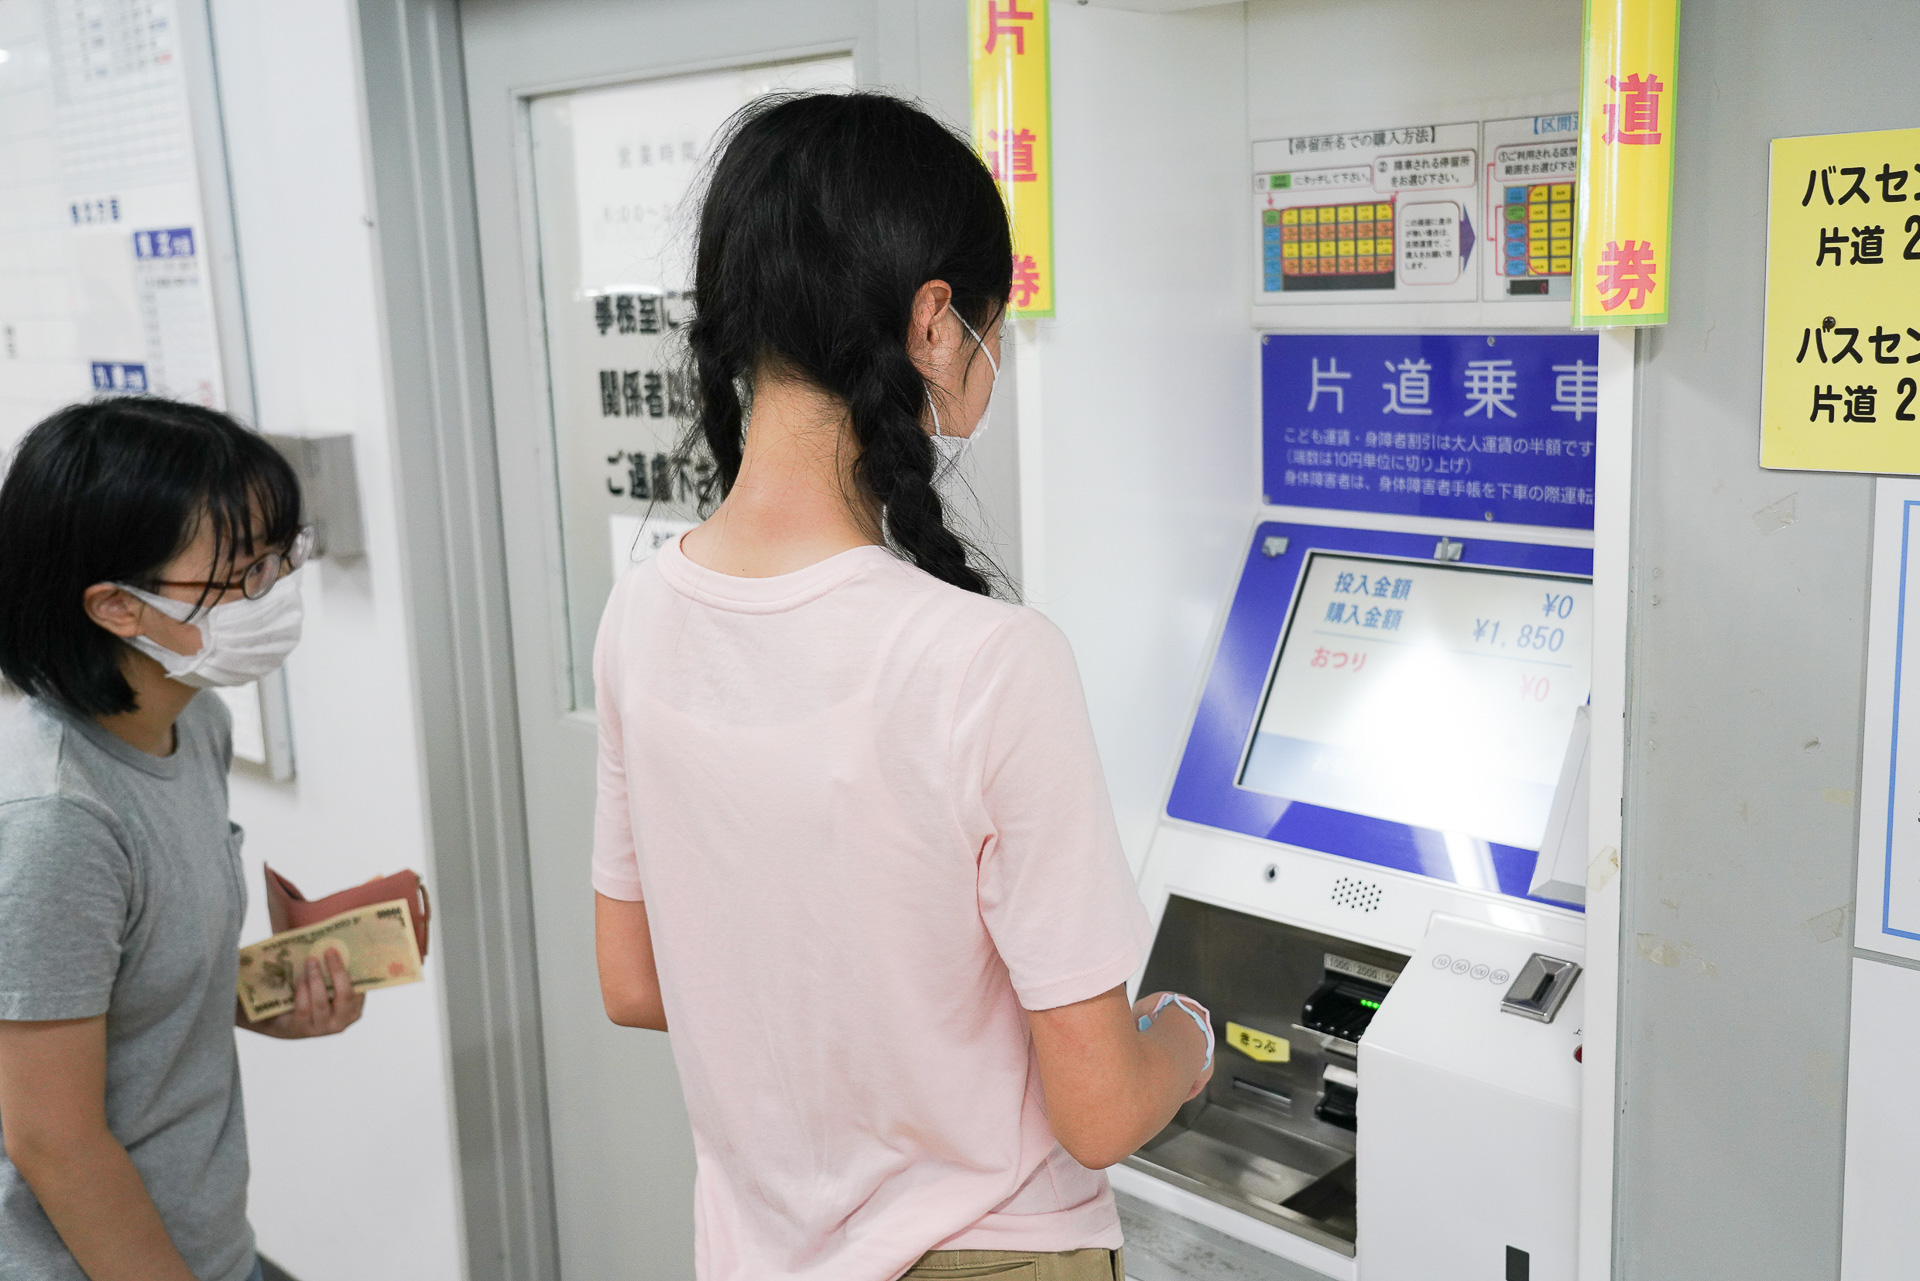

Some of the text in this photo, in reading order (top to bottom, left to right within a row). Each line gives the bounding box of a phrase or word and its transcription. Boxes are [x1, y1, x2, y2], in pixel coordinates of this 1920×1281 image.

[1505, 160, 1576, 175] 範囲をお選び下さ
[1802, 163, 1920, 207] バスセ
[1596, 73, 1664, 312] 道券
[1816, 225, 1884, 266] 片道
[595, 291, 698, 336] 事務室に
[1306, 356, 1597, 422] 片道乗車
[1810, 377, 1917, 423] 片道 2
[1324, 602, 1404, 632] 購入金額
[1334, 571, 1573, 619] 投入金額 ¥0
[1310, 645, 1551, 702] おつり ¥0
[1454, 962, 1467, 971] 50
[1473, 967, 1487, 977] 100
[1492, 972, 1507, 982] 500
